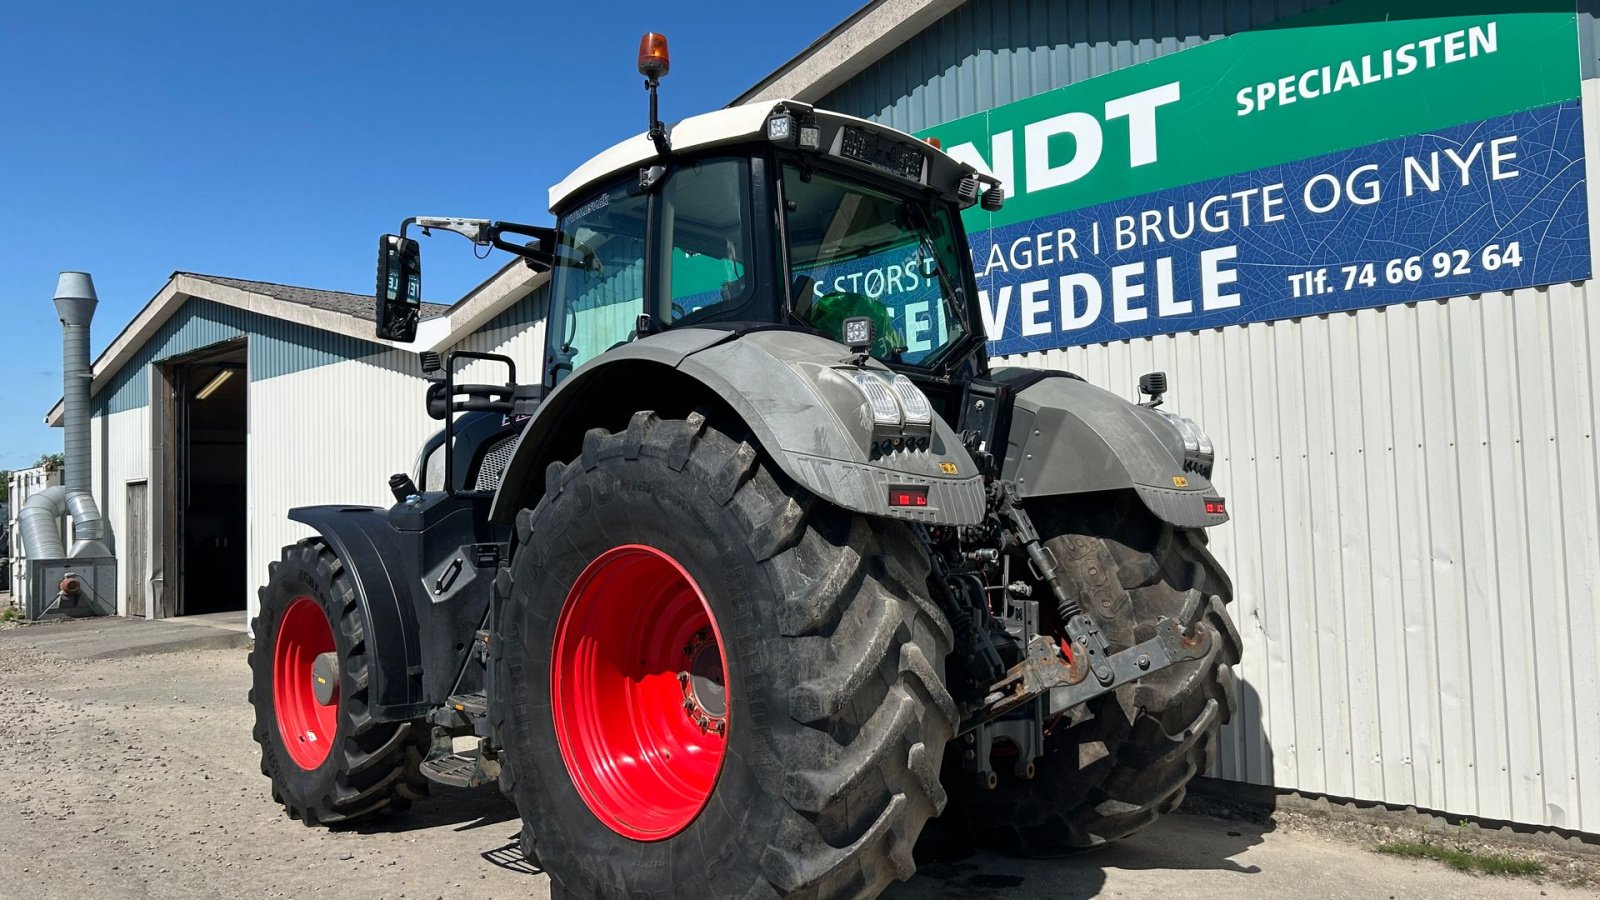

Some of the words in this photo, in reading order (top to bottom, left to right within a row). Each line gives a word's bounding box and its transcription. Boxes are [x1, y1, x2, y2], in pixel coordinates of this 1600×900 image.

[1235, 21, 1498, 117] SPECIALISTEN
[1092, 221, 1100, 255] I
[1115, 182, 1286, 251] BRUGTE
[1303, 163, 1381, 213] OG
[1403, 135, 1520, 197] NYE
[1287, 268, 1334, 298] Tlf.
[1341, 262, 1377, 291] 74
[1385, 255, 1423, 284] 66
[1432, 248, 1471, 279] 92
[1481, 241, 1523, 271] 64
